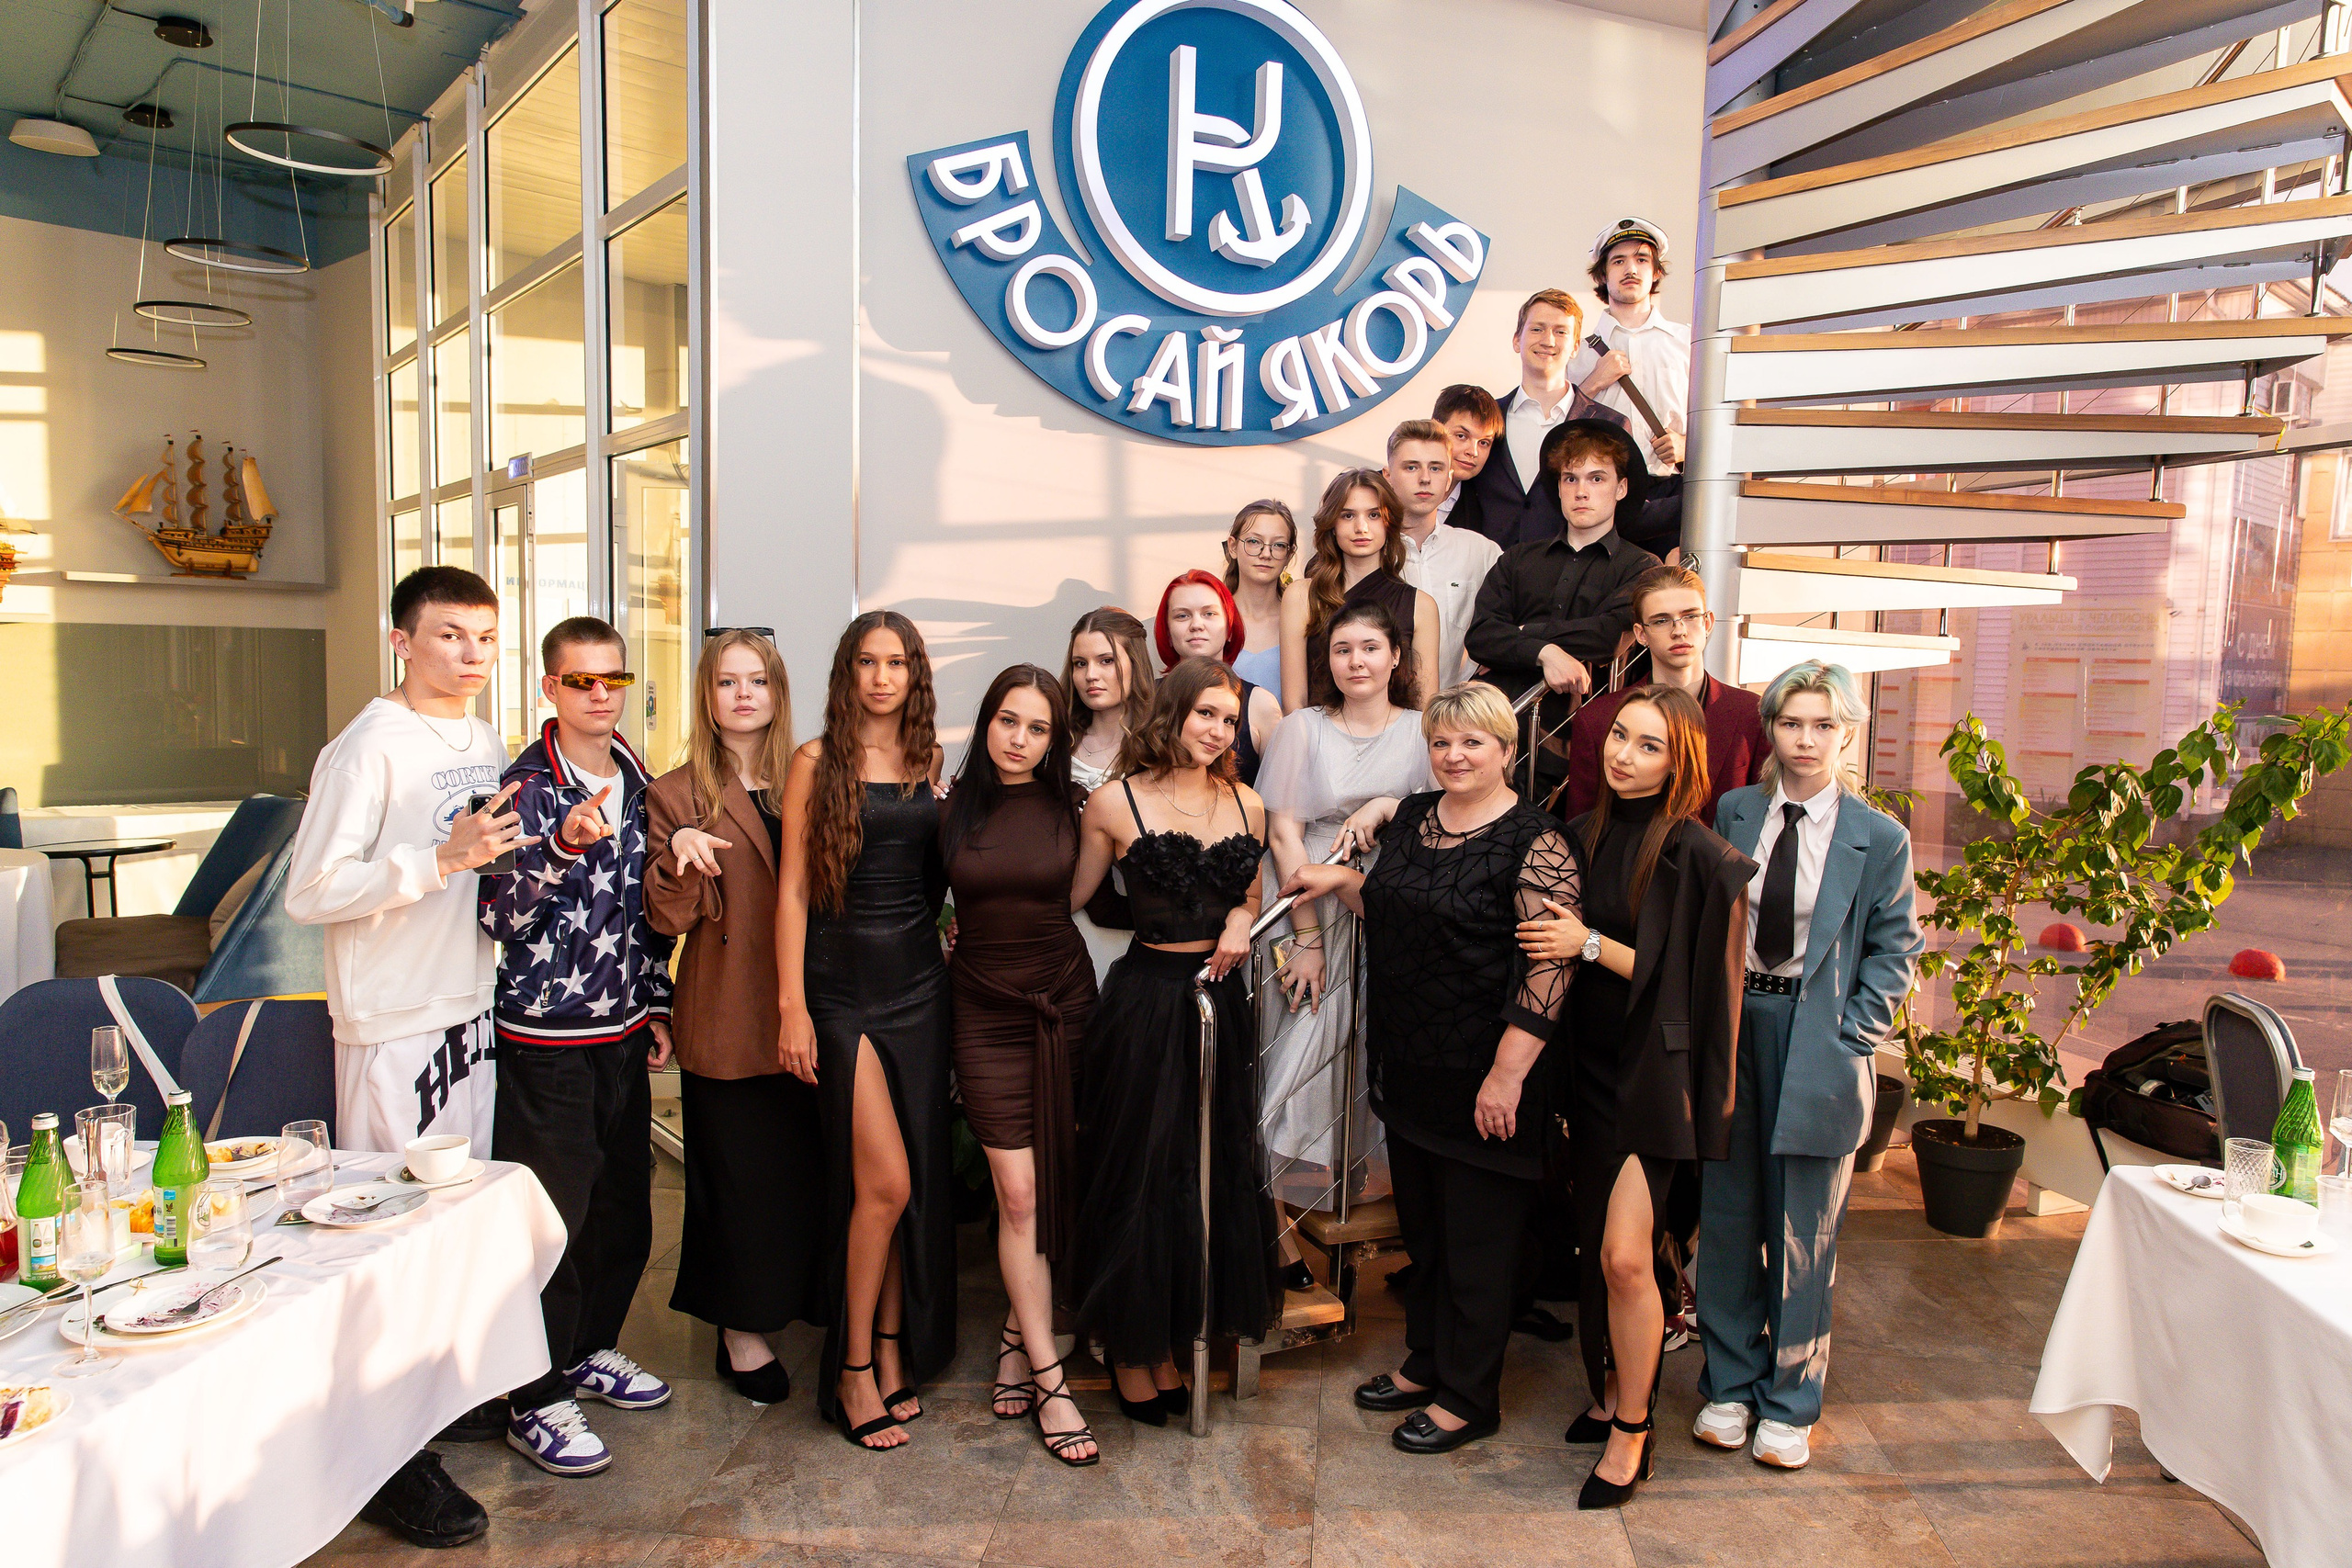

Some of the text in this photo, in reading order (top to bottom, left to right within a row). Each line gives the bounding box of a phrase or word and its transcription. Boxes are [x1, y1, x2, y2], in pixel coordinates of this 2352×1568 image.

[926, 141, 1485, 431] БРОСАЙ ЯКОРЬ
[506, 577, 585, 590] ИОРМАЦ
